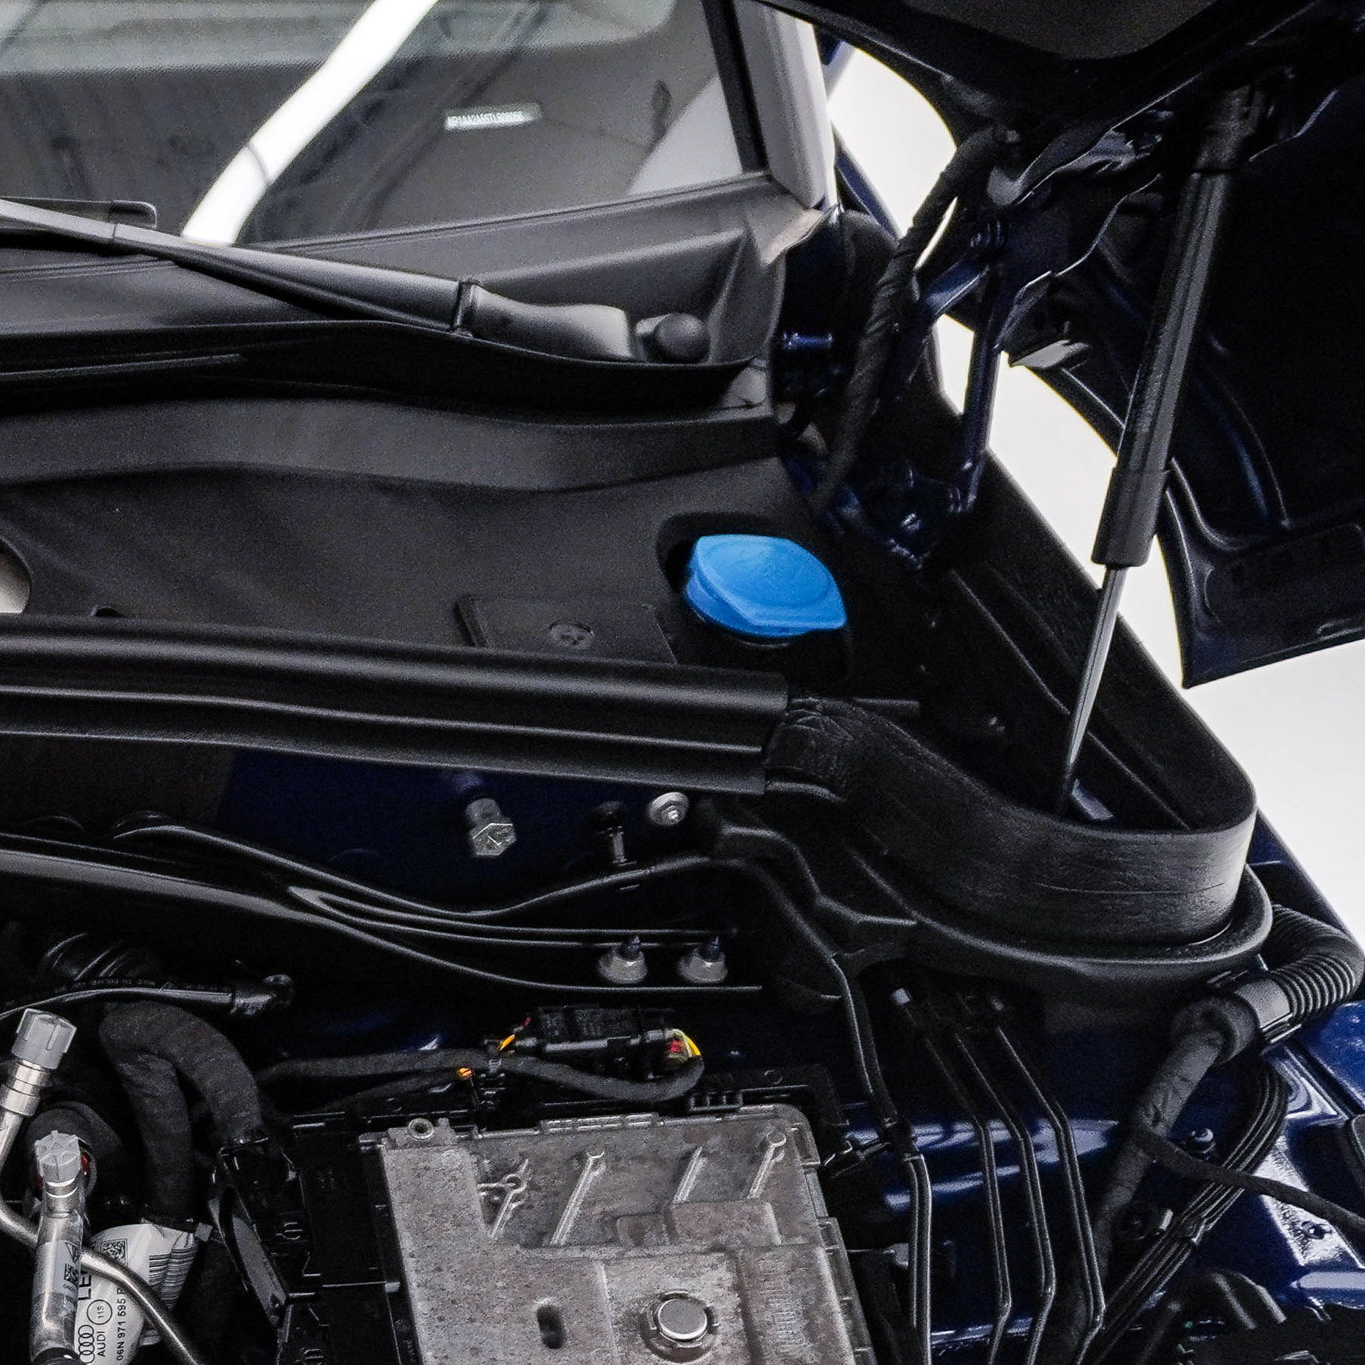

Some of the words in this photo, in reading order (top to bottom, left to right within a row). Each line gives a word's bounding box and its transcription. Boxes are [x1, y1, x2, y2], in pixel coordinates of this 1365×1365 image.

[78, 1270, 92, 1300] LE
[117, 1298, 127, 1318] 595
[117, 1322, 126, 1340] 971
[97, 1330, 106, 1357] AUDI
[116, 1342, 126, 1361] 06N
